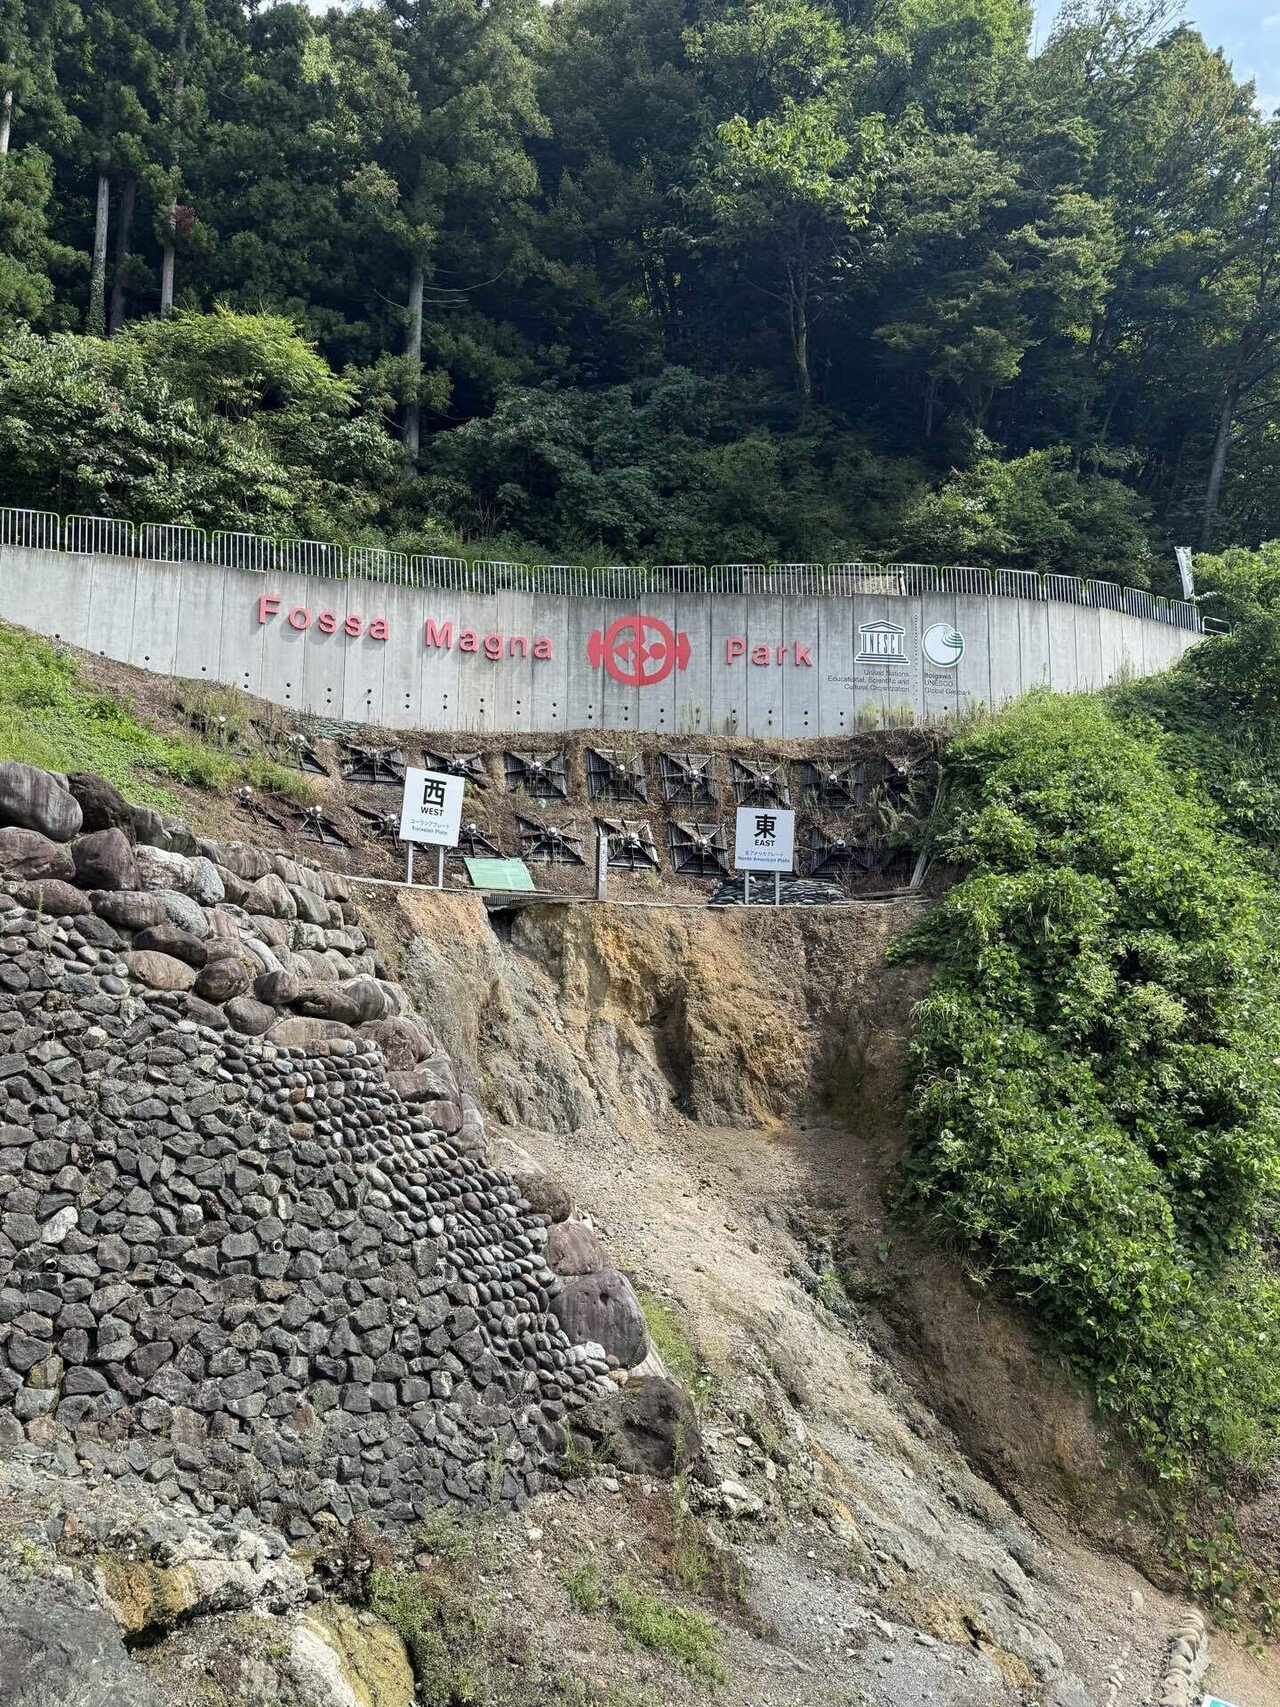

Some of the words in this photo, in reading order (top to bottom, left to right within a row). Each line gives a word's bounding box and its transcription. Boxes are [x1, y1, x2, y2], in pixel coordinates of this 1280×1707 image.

[258, 594, 391, 640] Fossa
[425, 618, 553, 660] Magna
[726, 636, 813, 667] Park
[862, 633, 903, 654] UNESCO
[864, 669, 884, 677] United
[886, 670, 910, 678] Nations
[868, 677, 896, 685] Scientific
[844, 683, 869, 691] Cultural
[870, 685, 910, 693] Organization
[924, 687, 945, 695] Global
[945, 688, 971, 696] Geopark
[423, 778, 447, 807] 西
[420, 806, 444, 816] WEST
[754, 814, 777, 838] 東
[754, 839, 776, 847] EAST
